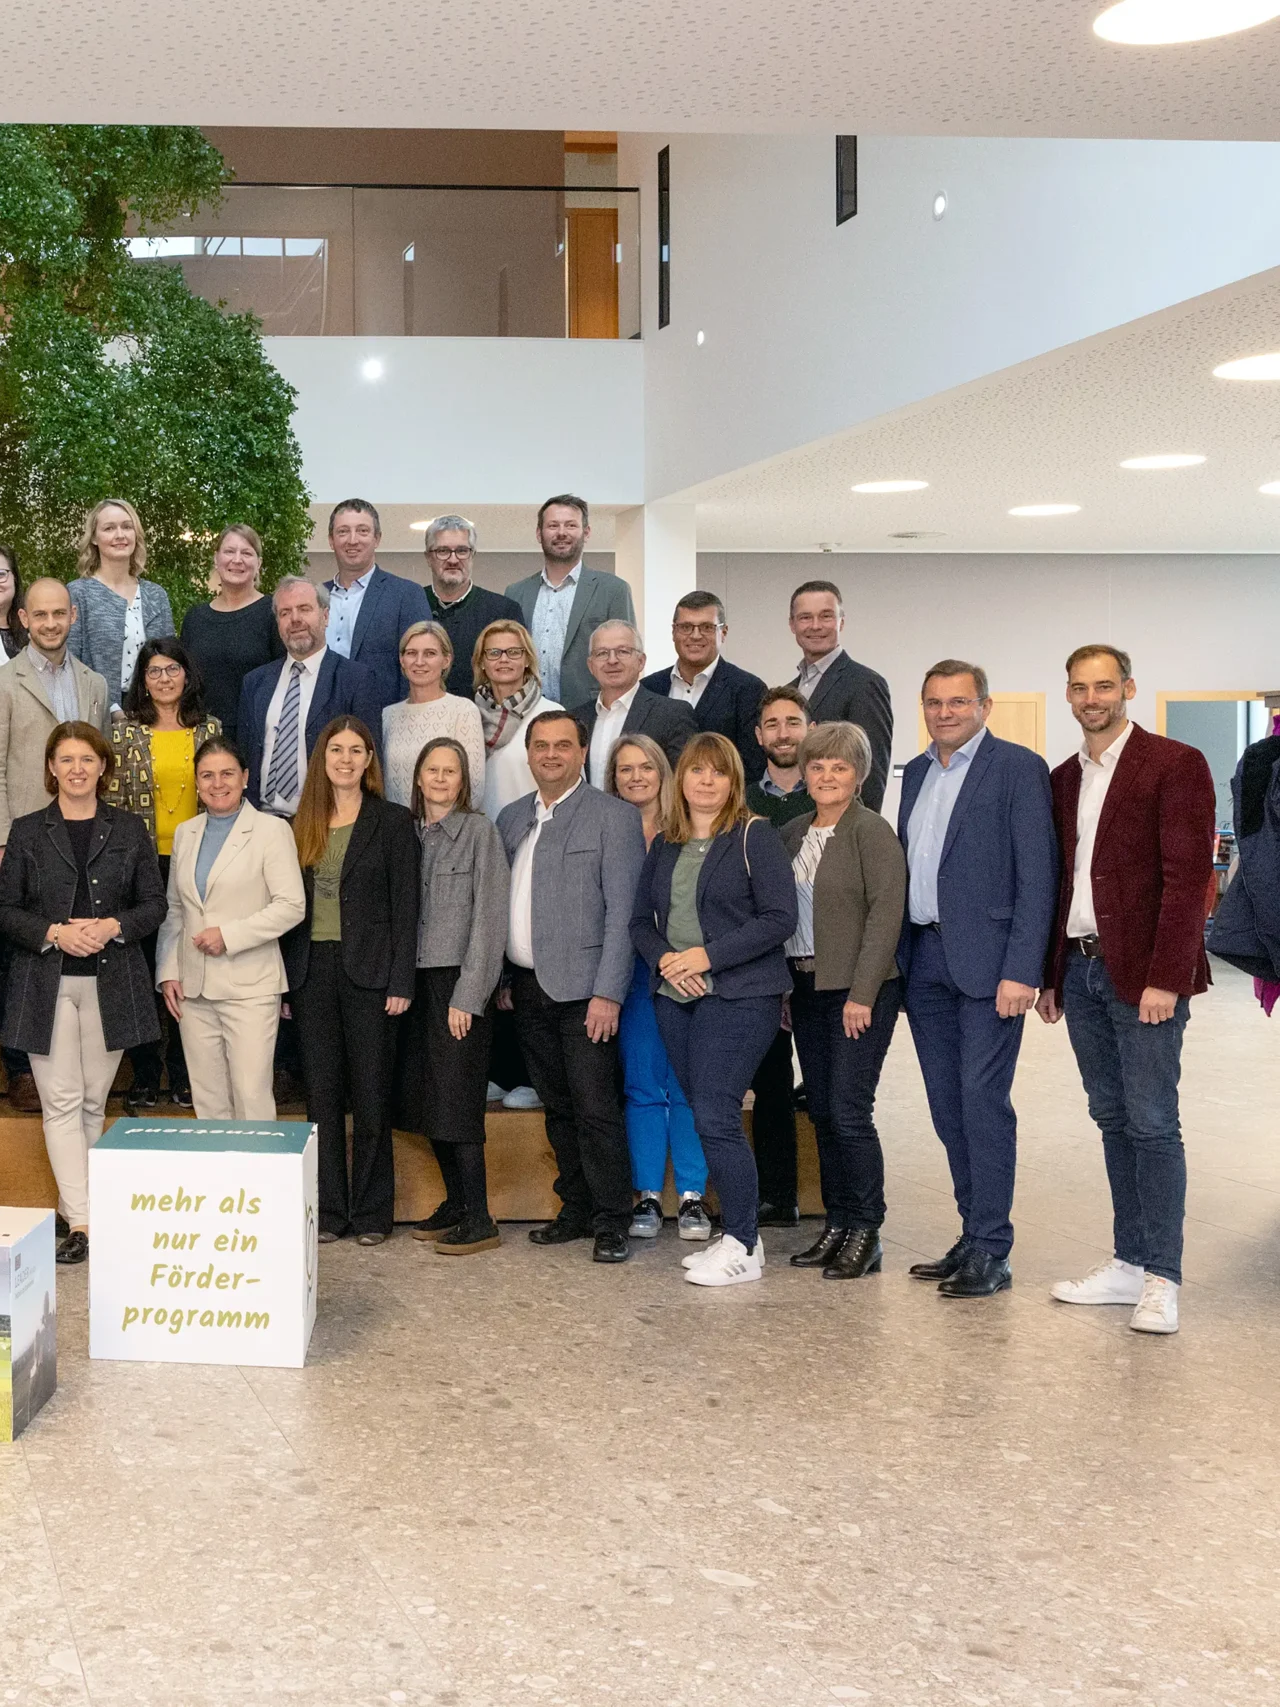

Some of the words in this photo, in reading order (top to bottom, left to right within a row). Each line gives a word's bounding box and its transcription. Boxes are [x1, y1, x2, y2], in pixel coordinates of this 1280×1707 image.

[130, 1186, 207, 1213] mehr
[218, 1188, 262, 1215] als
[152, 1231, 201, 1250] nur
[213, 1228, 258, 1253] ein
[150, 1263, 261, 1291] Förder-
[121, 1305, 271, 1335] programm
